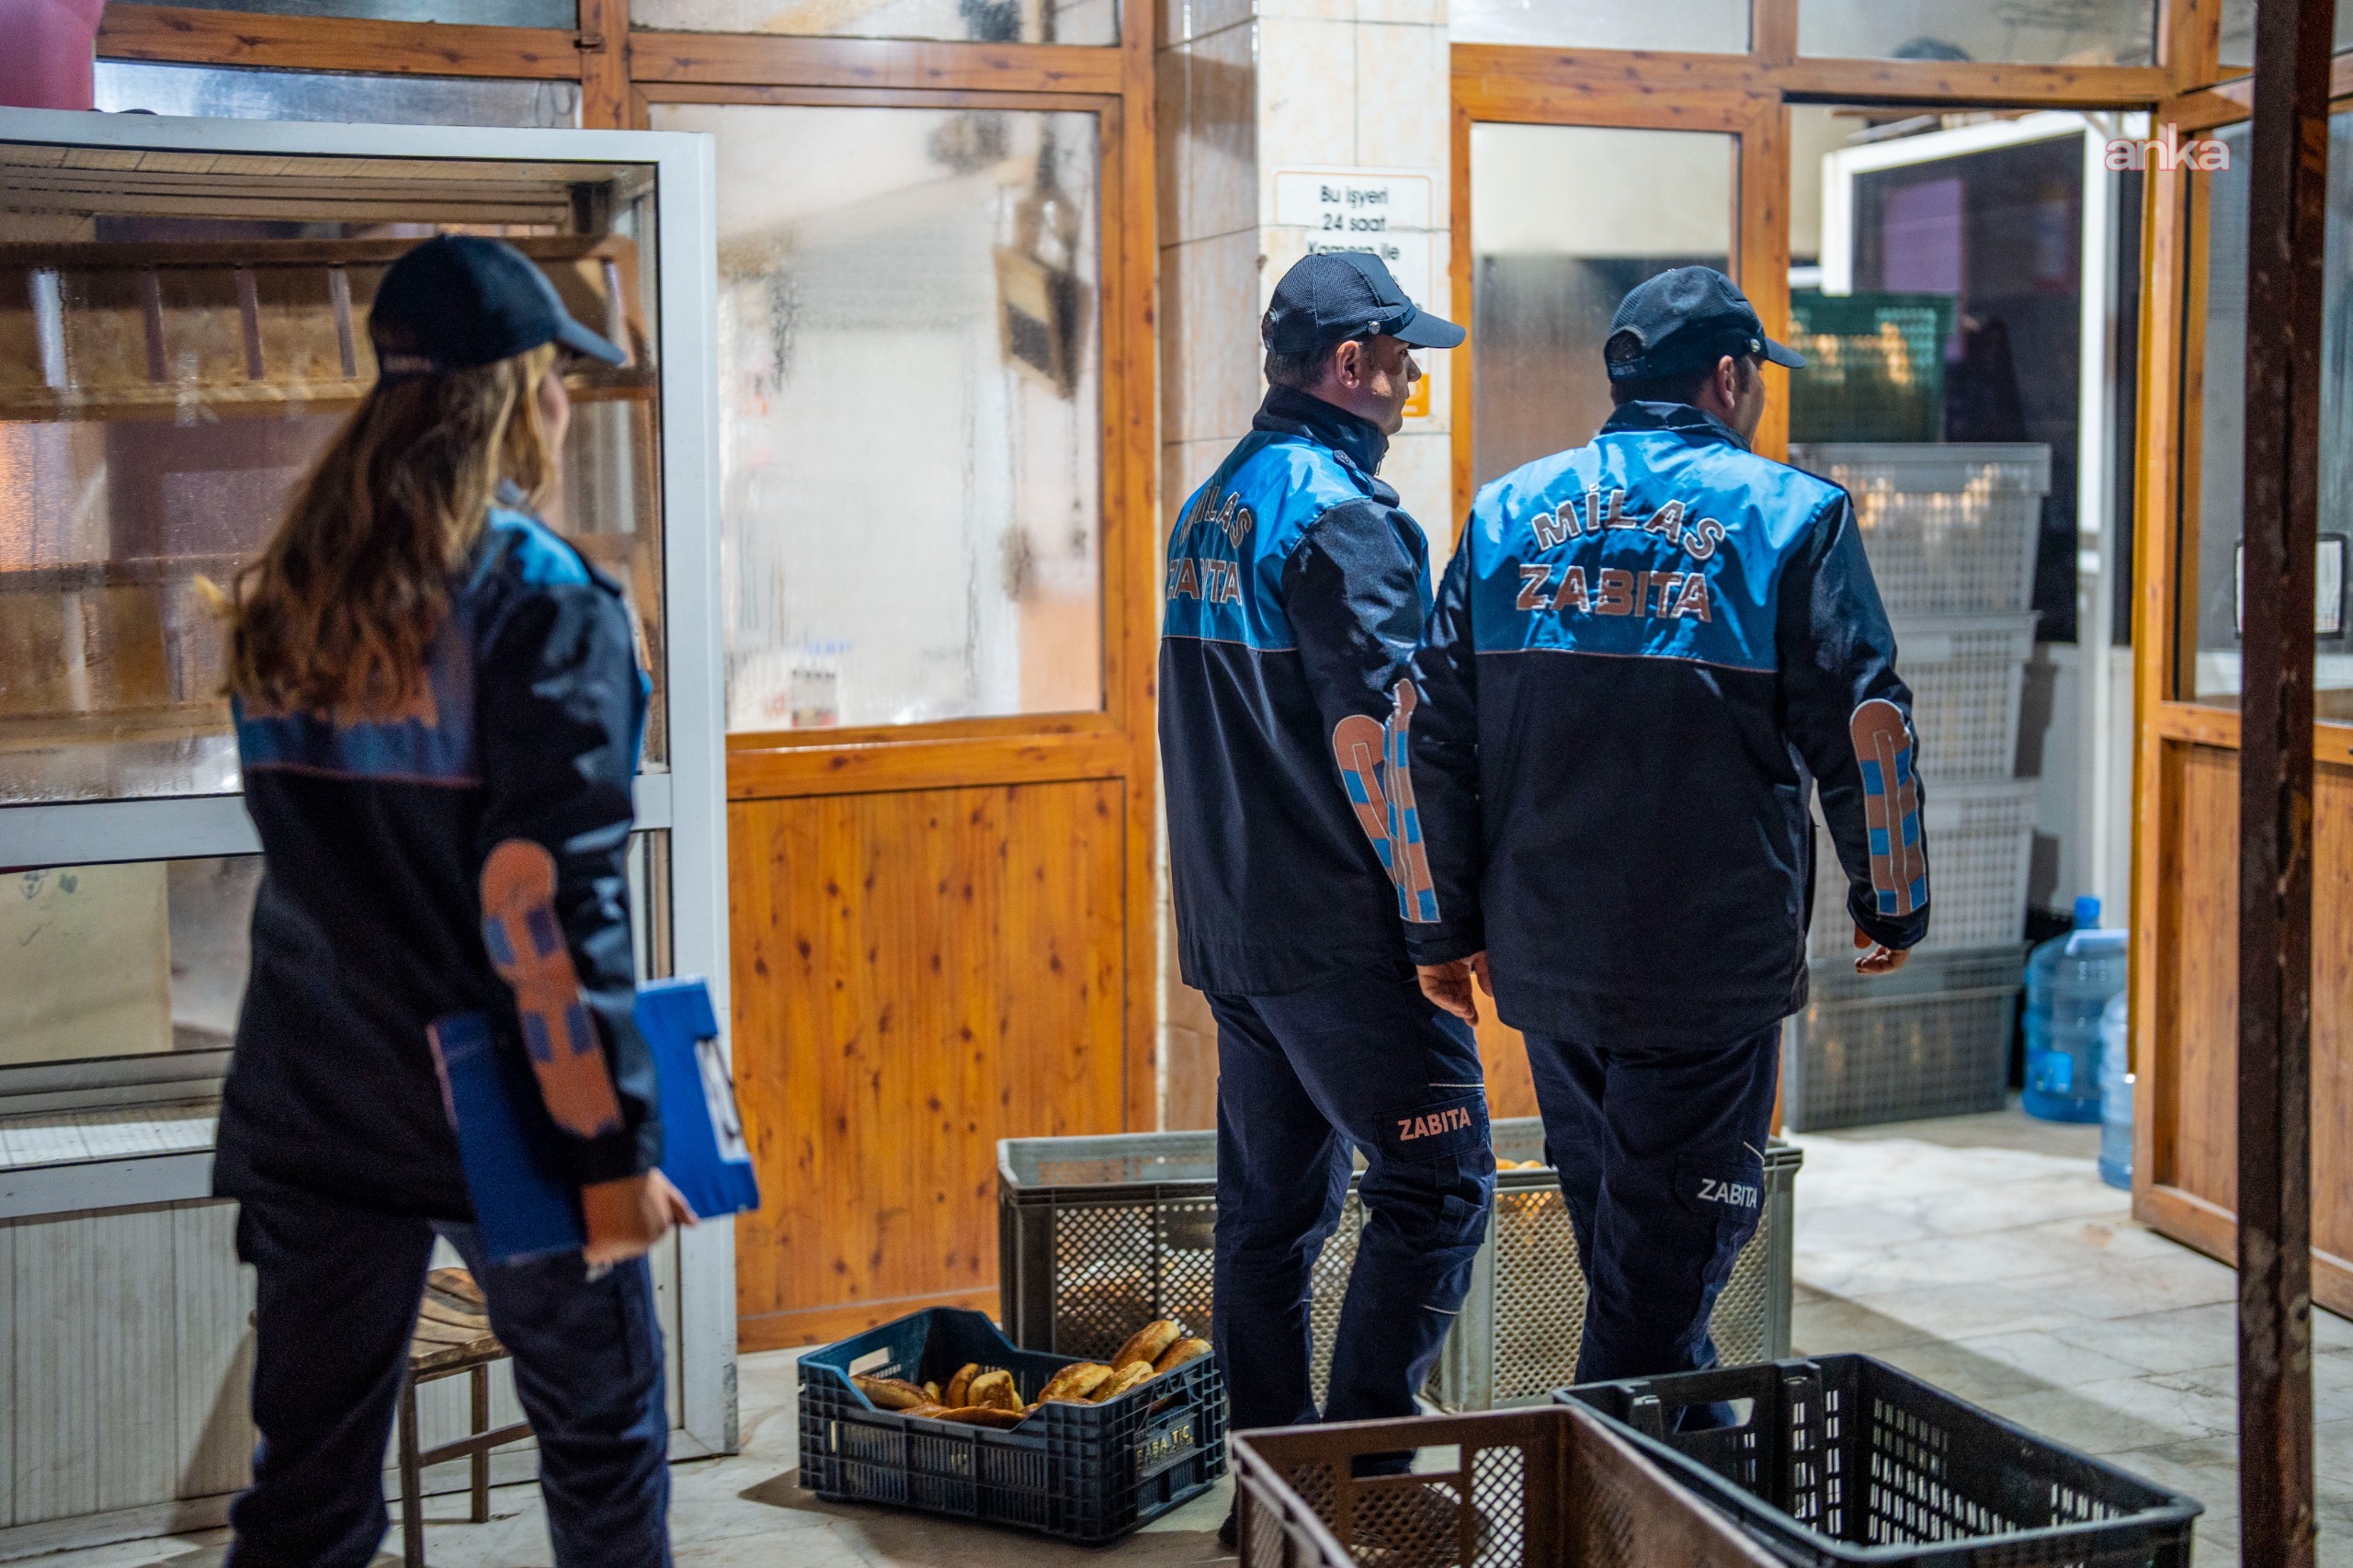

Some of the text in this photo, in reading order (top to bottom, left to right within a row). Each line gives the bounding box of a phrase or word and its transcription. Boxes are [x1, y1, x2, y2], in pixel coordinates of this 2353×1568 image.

[1320, 186, 1389, 208] Bu işyeri
[1322, 213, 1386, 232] 24 saat
[1381, 242, 1400, 260] ile
[1530, 483, 1726, 561] MİLAS
[1516, 563, 1712, 623] ZABITA
[1397, 1107, 1472, 1142] ZABITA
[1697, 1177, 1758, 1209] ZABITA
